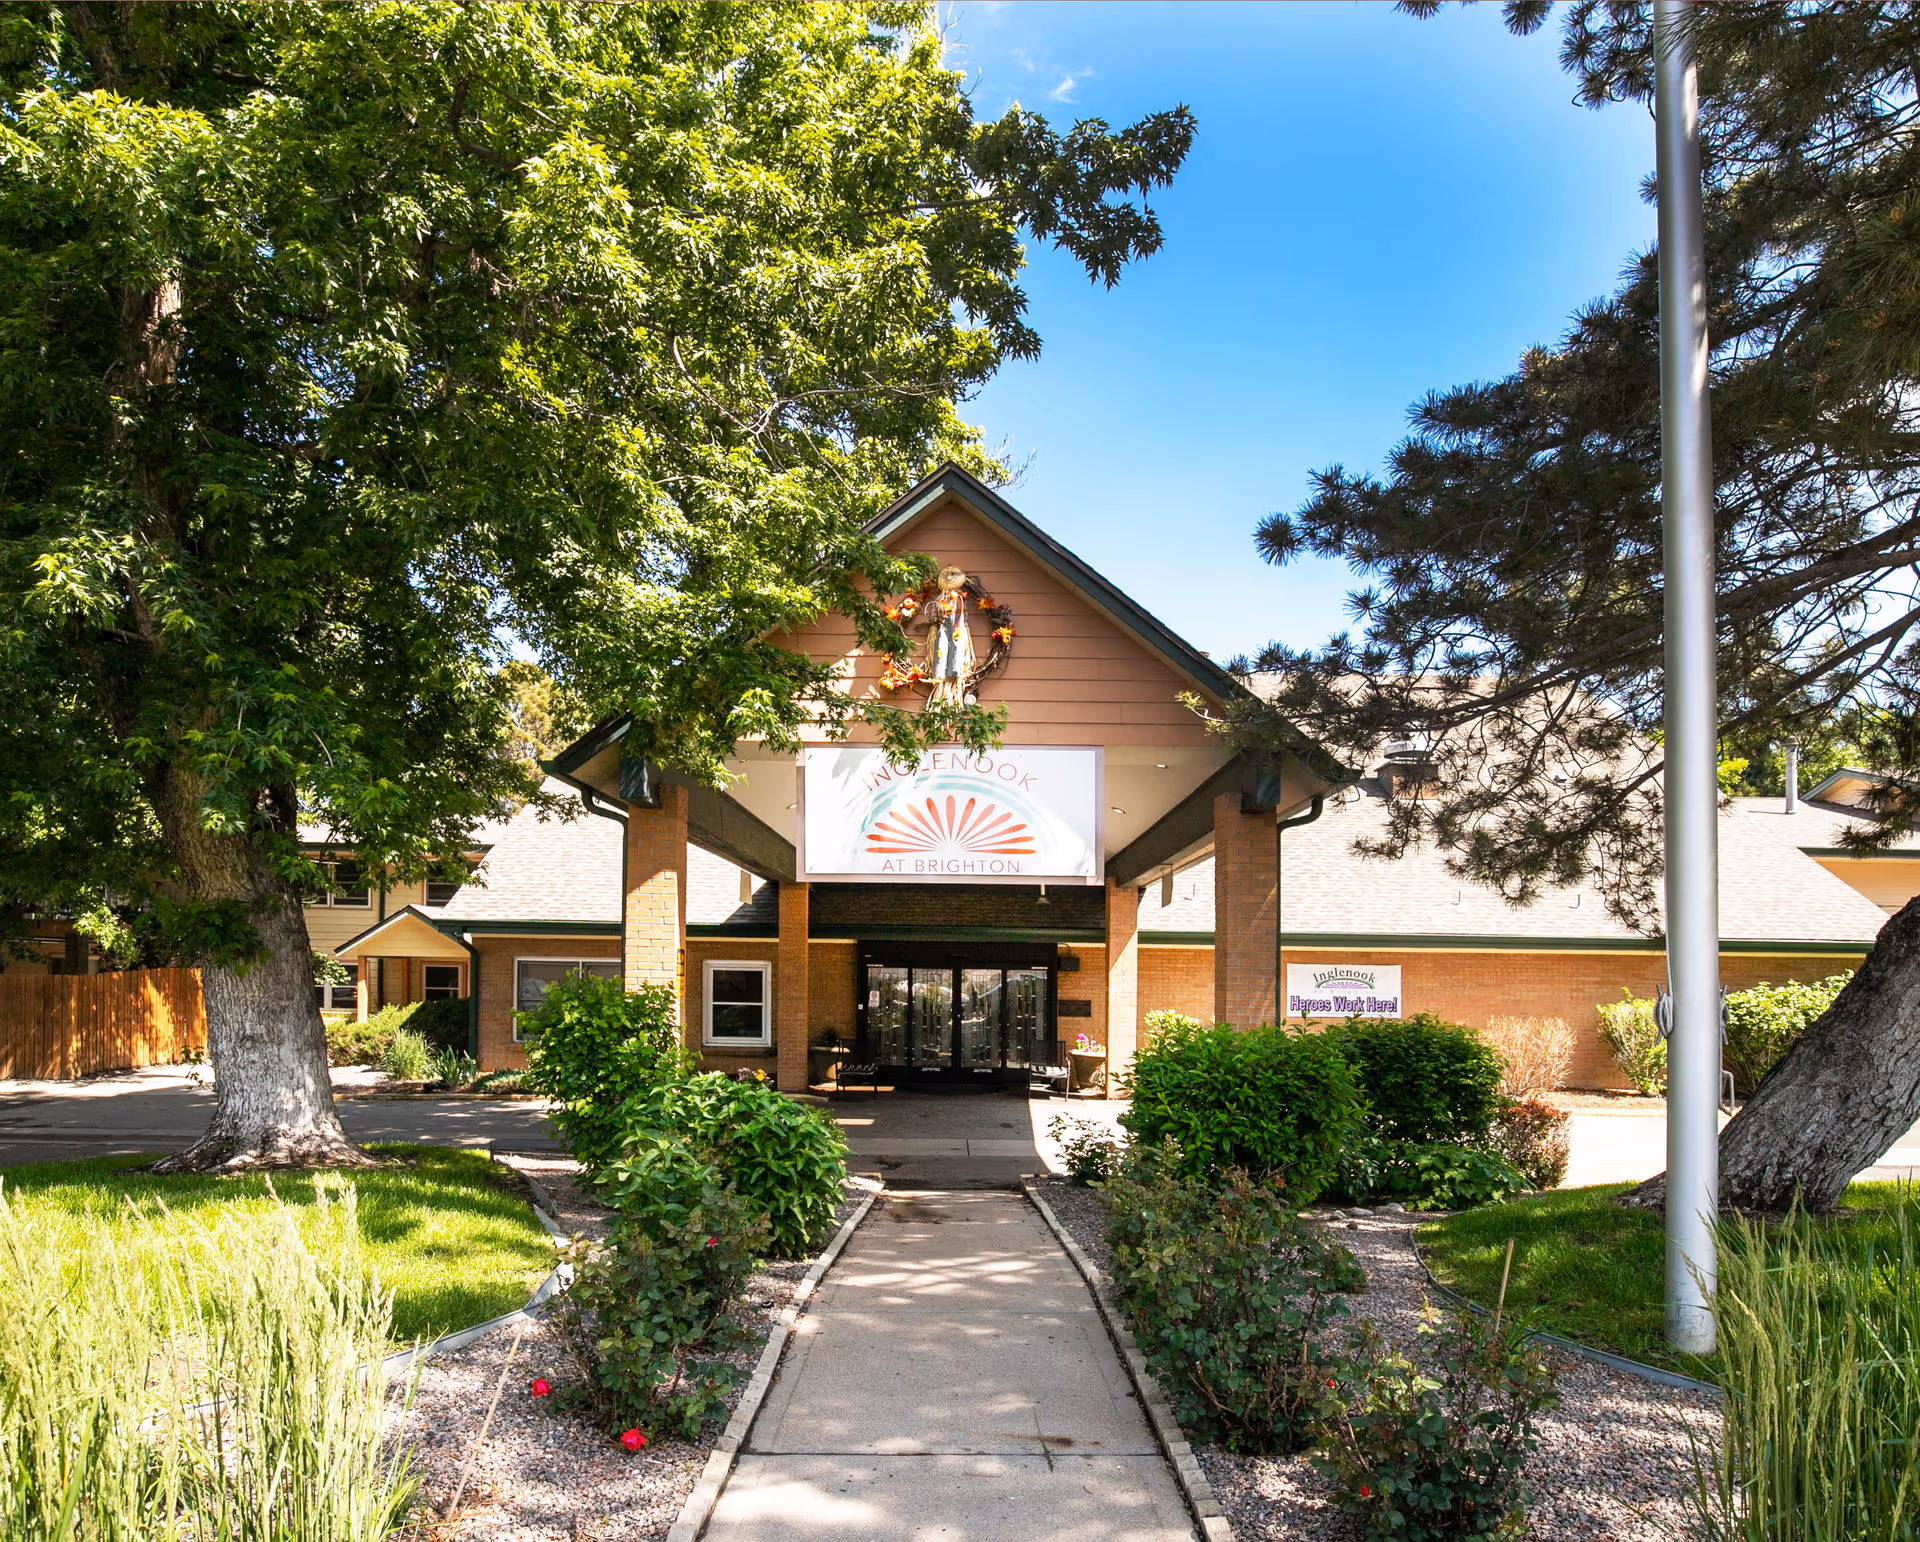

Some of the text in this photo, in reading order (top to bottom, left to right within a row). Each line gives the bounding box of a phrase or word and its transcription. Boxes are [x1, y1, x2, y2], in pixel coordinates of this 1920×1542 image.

[861, 752, 1039, 792] INENOOK
[882, 859, 1020, 873] AT BRIGHTON
[1313, 967, 1376, 984] Inglenook
[1290, 995, 1398, 1013] Heroes Work Here!
